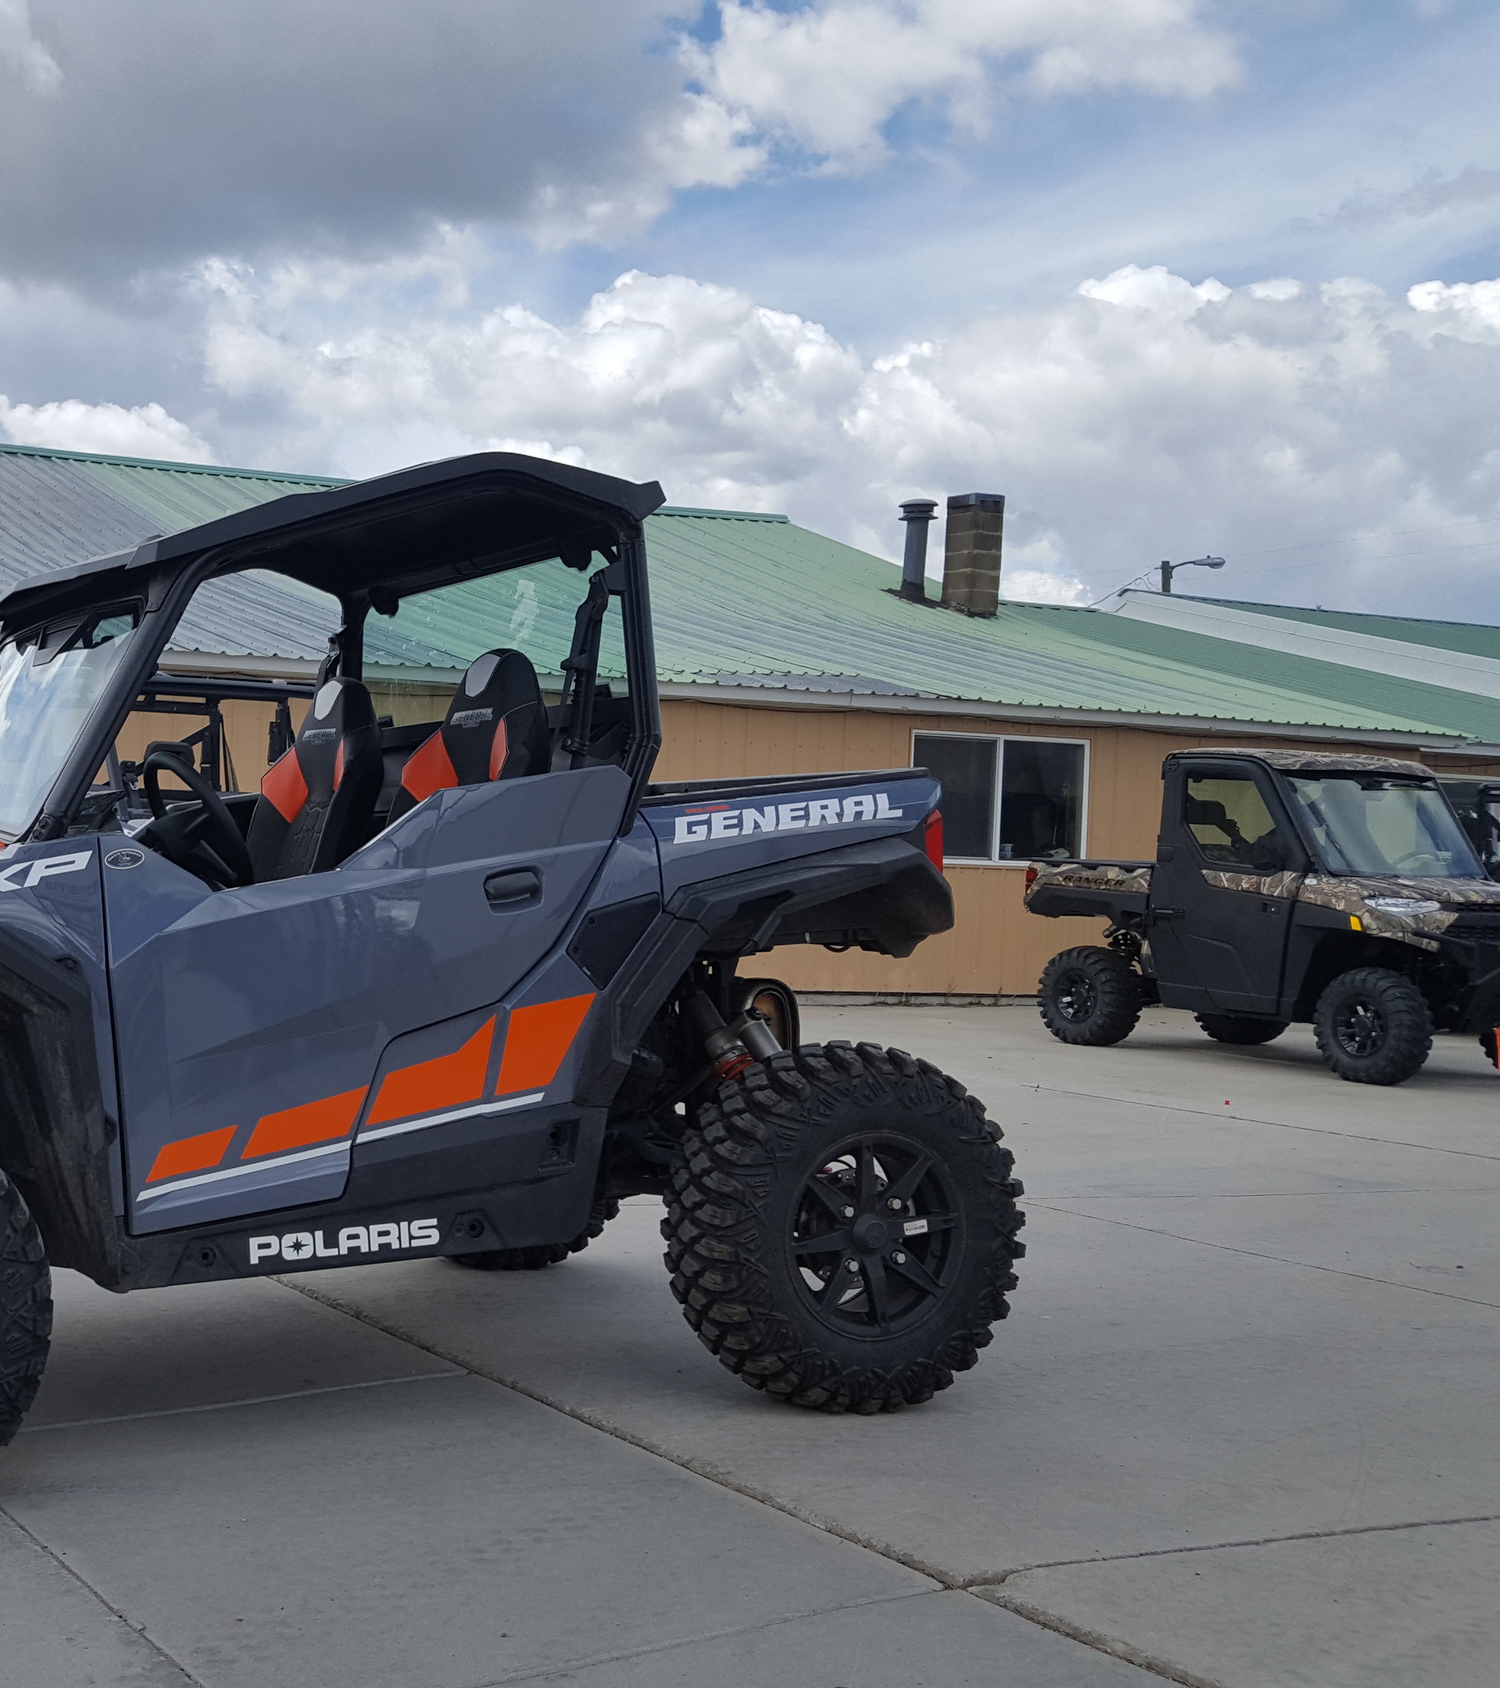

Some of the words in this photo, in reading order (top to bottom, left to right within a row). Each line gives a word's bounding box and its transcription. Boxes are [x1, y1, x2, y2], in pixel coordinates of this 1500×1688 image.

[673, 793, 903, 845] GENERAL
[1062, 874, 1125, 886] RANGER
[249, 1217, 440, 1264] POLARIS
